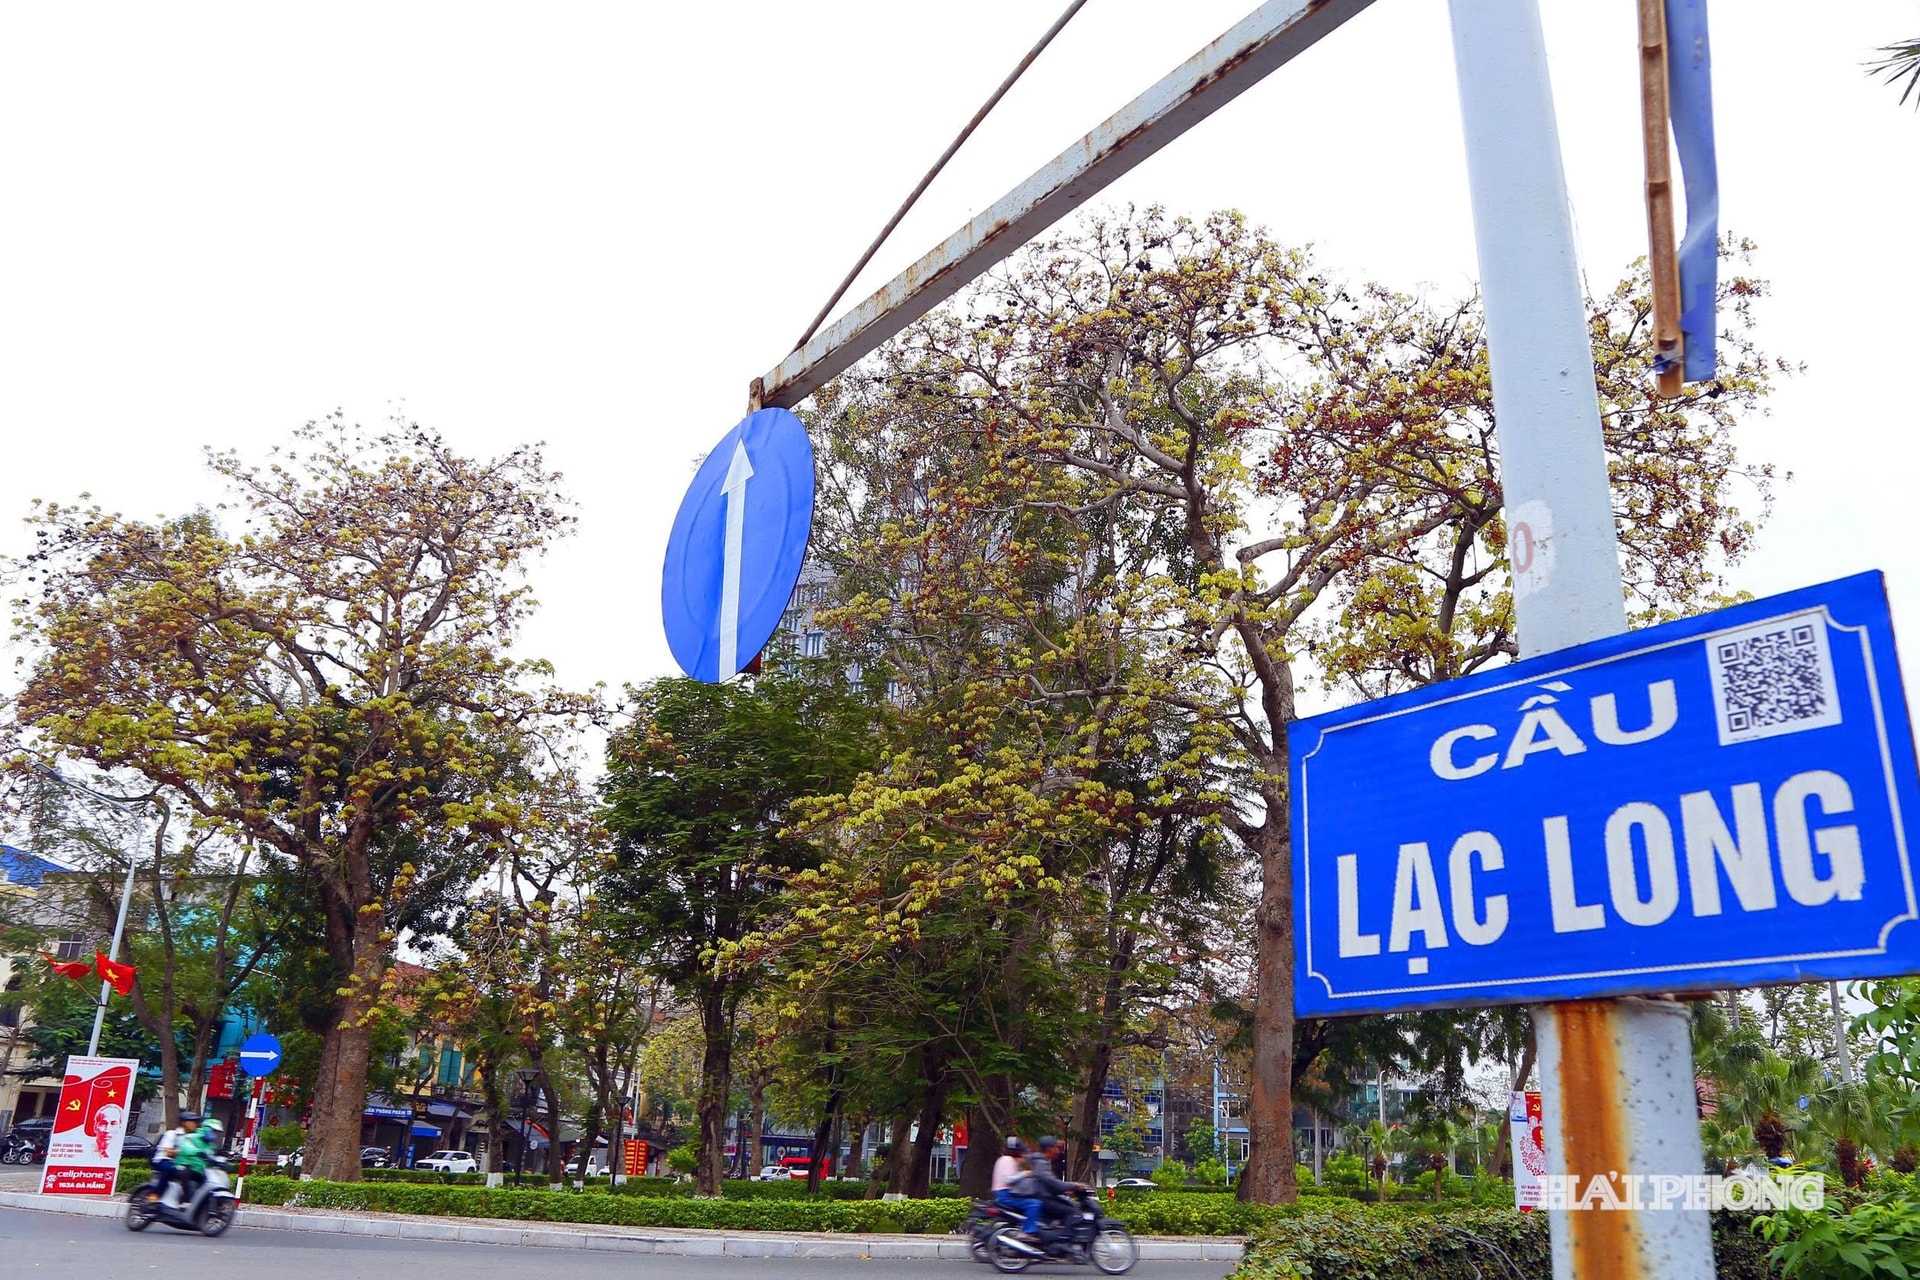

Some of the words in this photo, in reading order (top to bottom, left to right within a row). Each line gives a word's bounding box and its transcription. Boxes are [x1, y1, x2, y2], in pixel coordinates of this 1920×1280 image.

[1429, 680, 1678, 781] CẦU
[1337, 830, 1509, 975] LẠC
[1543, 770, 1864, 934] LONG
